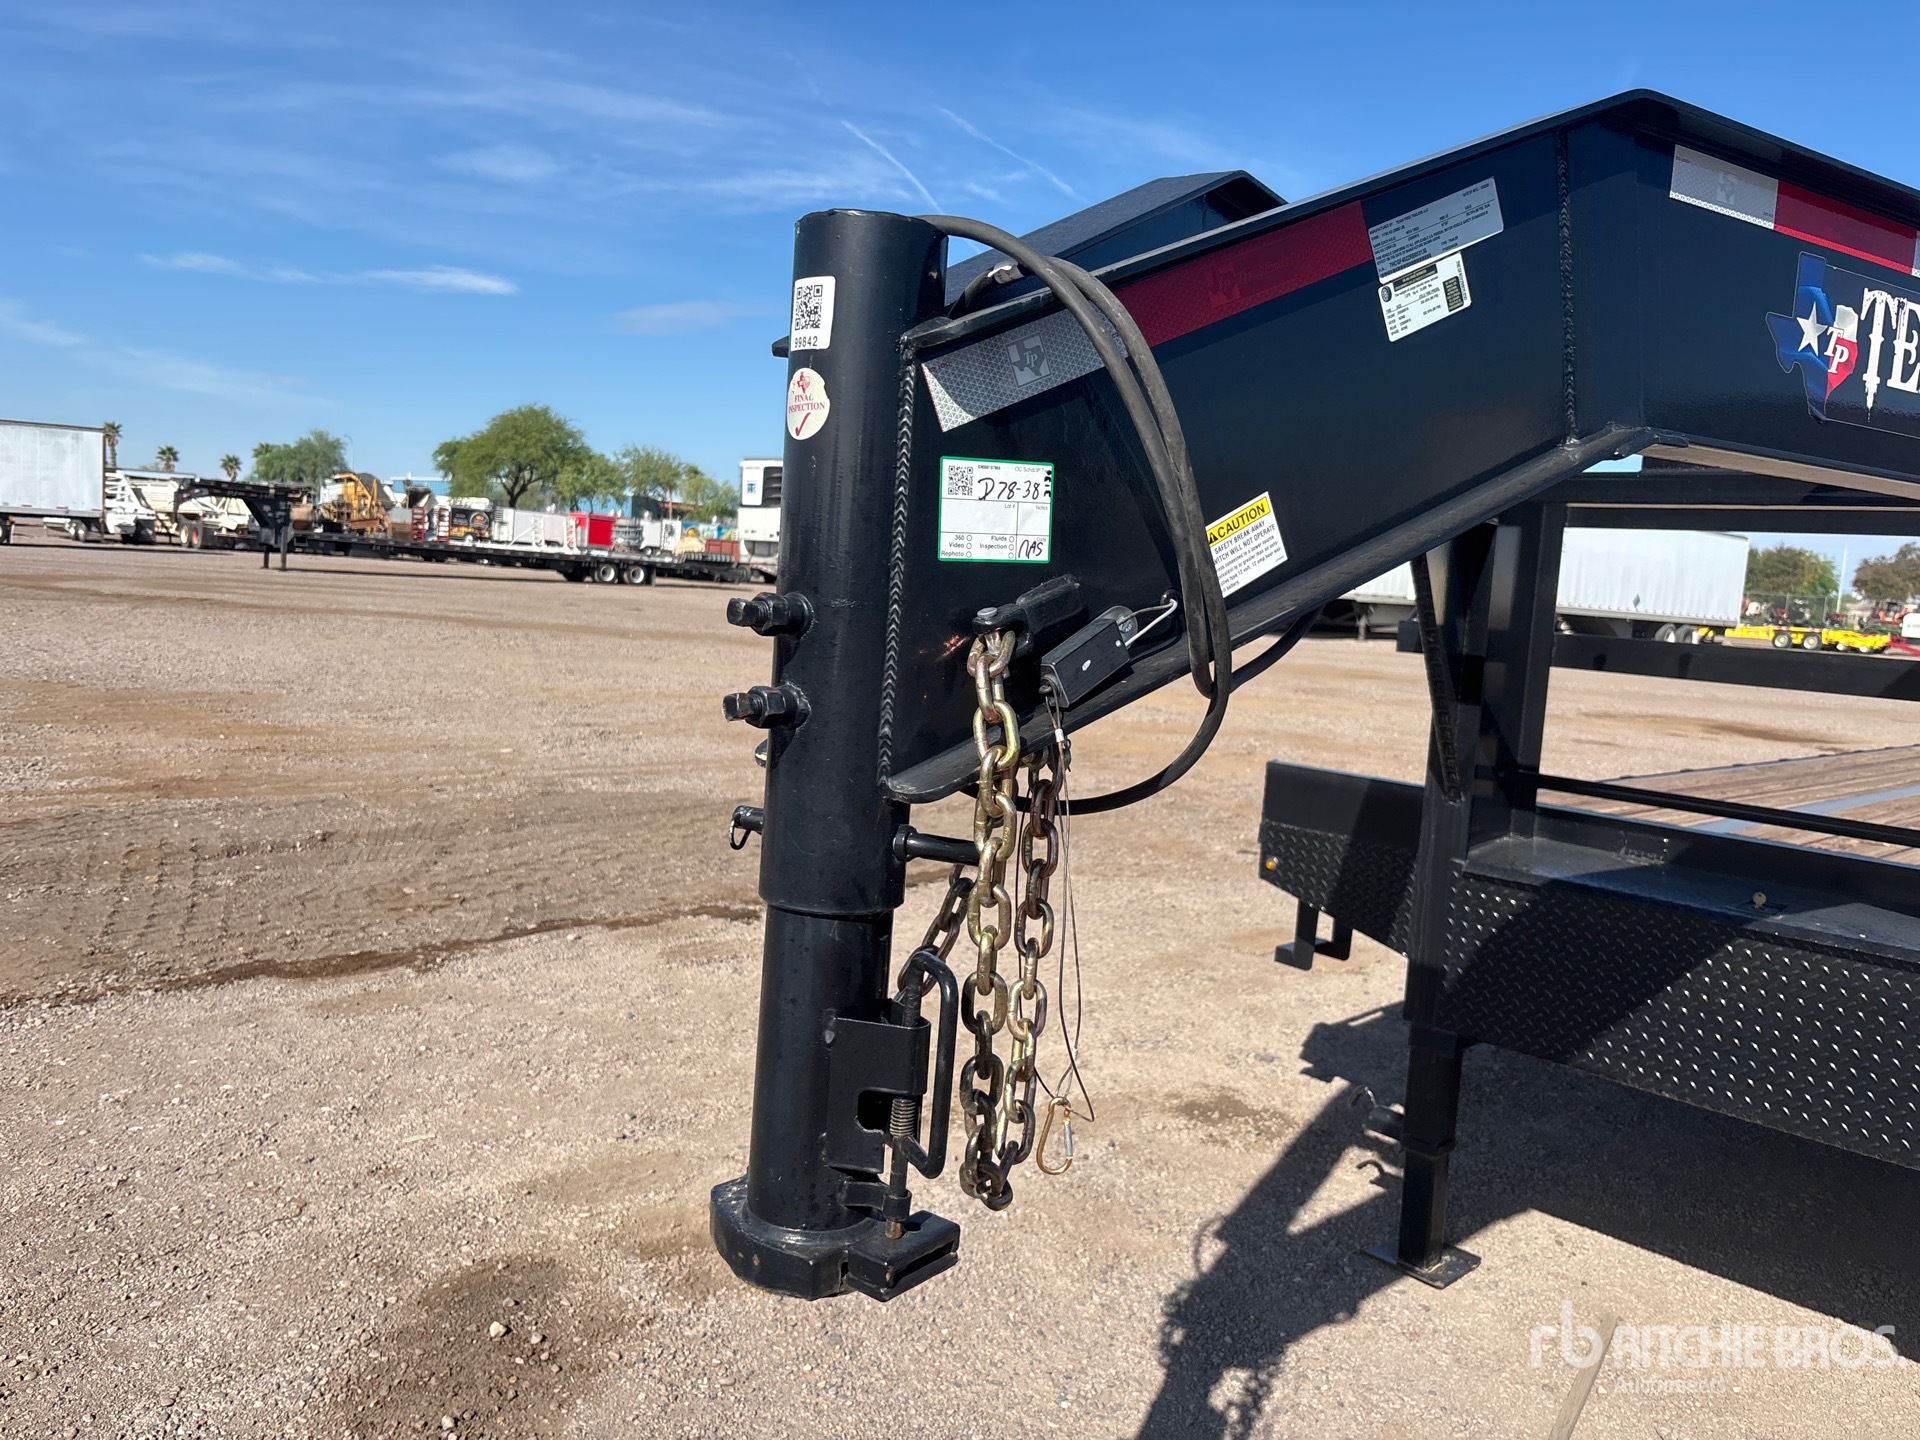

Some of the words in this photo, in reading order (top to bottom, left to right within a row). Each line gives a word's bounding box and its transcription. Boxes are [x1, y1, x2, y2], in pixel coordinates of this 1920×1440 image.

[794, 335, 818, 349] 99842
[1824, 327, 1849, 373] TP
[788, 401, 826, 414] INSPECTION
[794, 394, 814, 403] FINAL
[1217, 503, 1265, 537] CAUTION
[1213, 551, 1230, 565] WITCH
[1229, 544, 1243, 556] WILL
[1242, 537, 1254, 548] NOT
[1253, 523, 1276, 541] OPERATE
[1214, 539, 1233, 555] SAFETY
[1233, 520, 1266, 544] BREAK-AWAY
[941, 550, 965, 558] Rephoto
